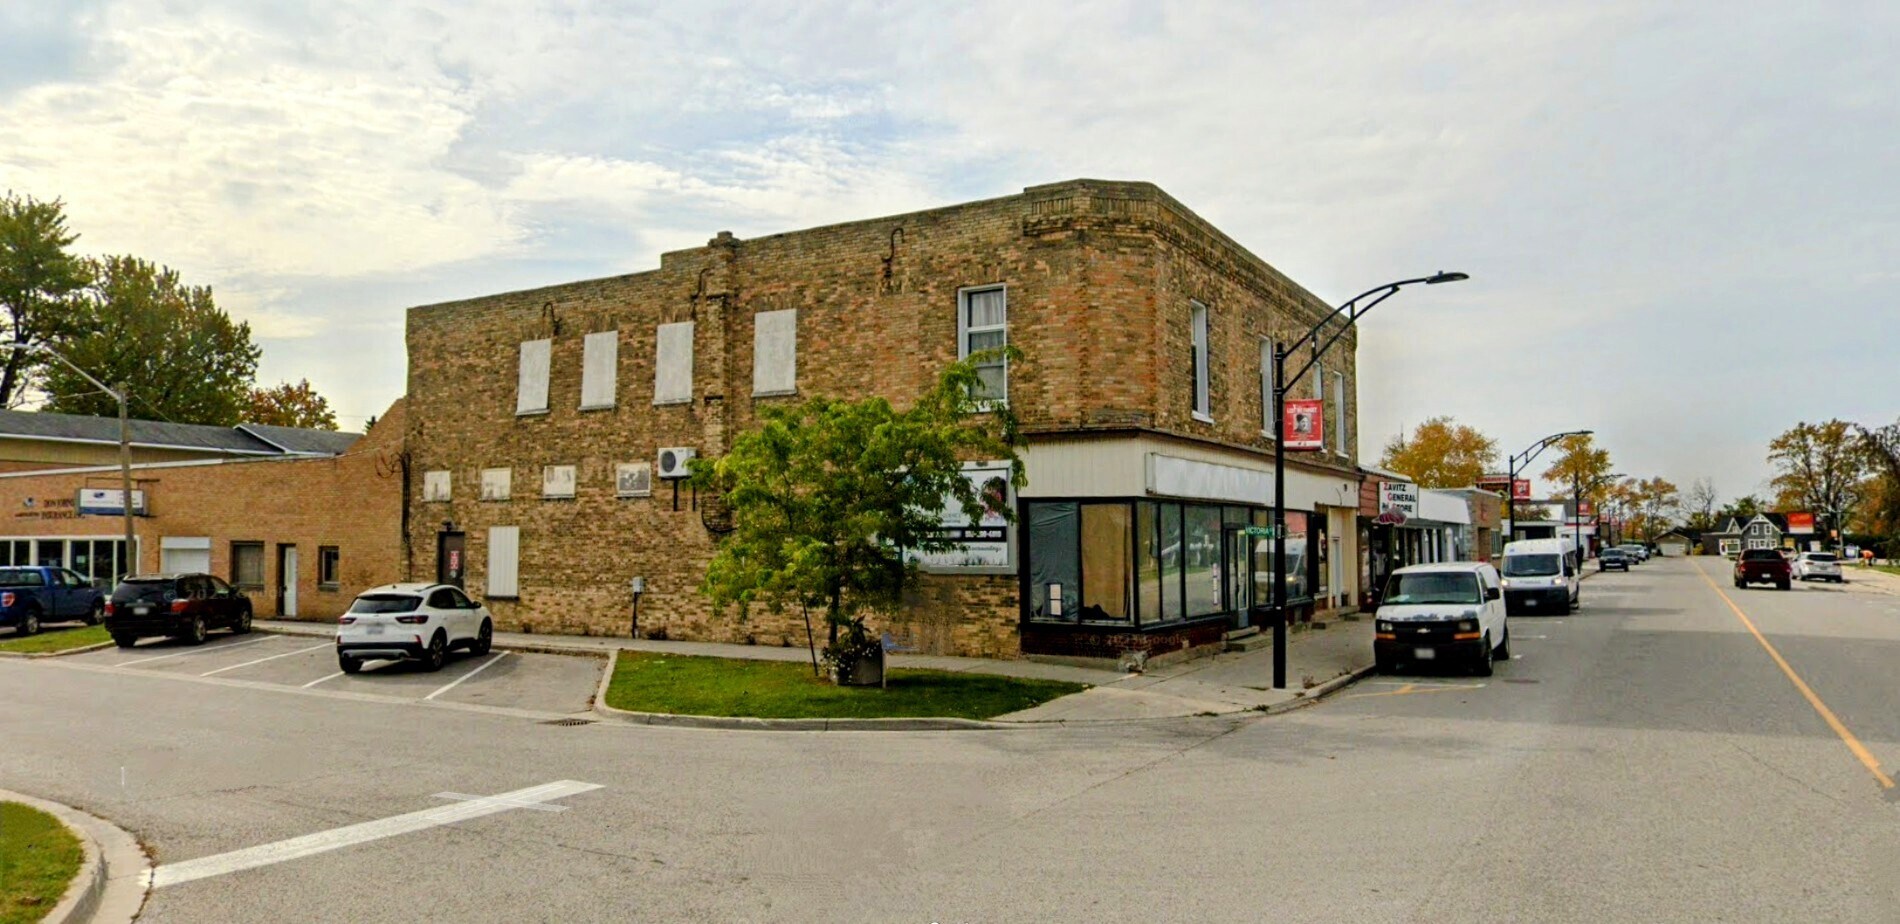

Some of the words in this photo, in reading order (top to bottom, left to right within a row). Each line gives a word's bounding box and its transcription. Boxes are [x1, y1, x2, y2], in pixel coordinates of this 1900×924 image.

[1383, 482, 1406, 491] ZAVITZ
[1387, 492, 1416, 502] GENERAL
[1391, 503, 1413, 513] STORE
[1245, 526, 1269, 536] VICTORIA
